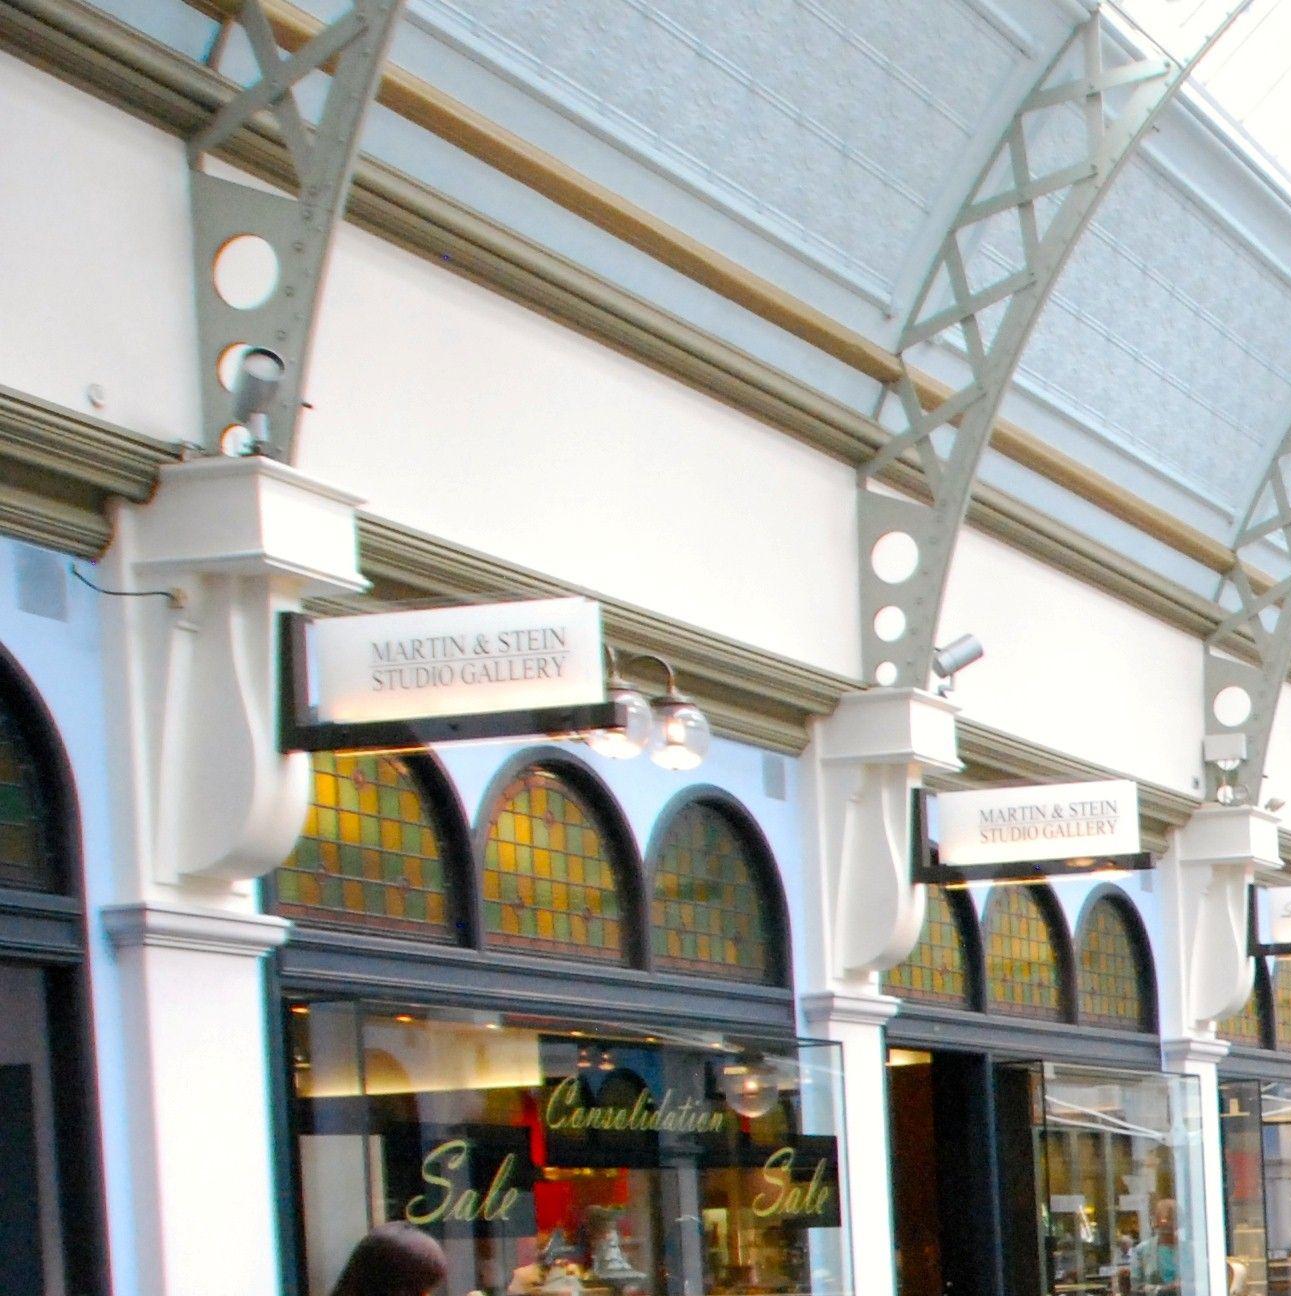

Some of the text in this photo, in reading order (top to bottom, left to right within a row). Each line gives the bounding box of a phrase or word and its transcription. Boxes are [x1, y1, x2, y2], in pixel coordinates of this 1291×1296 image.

[371, 627, 566, 662] MARTIN & STEIN
[372, 655, 566, 691] STUDIO GALLERY
[979, 800, 1119, 824] MARTIN & STEIN
[979, 819, 1117, 845] STUDIO GALLERY
[544, 1075, 724, 1134] Consolidation
[405, 1139, 520, 1224] Sale
[752, 1146, 830, 1218] Sale
